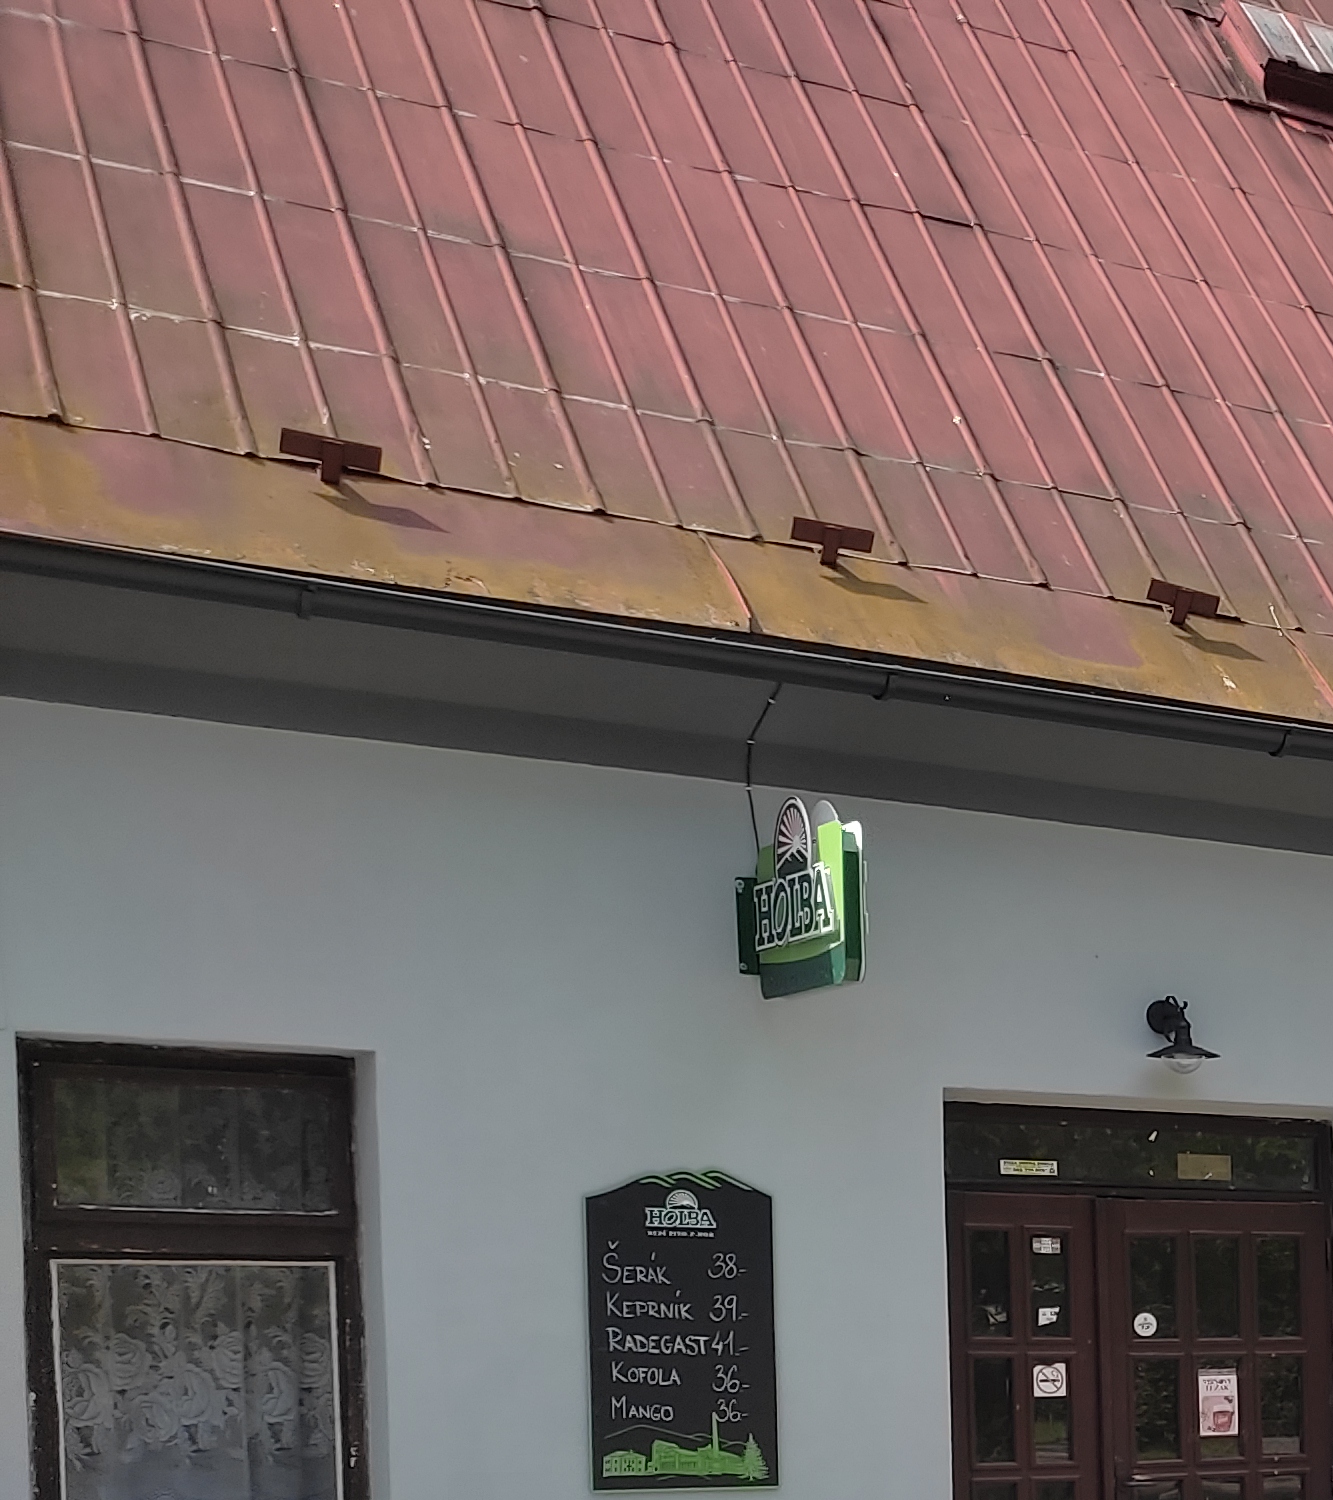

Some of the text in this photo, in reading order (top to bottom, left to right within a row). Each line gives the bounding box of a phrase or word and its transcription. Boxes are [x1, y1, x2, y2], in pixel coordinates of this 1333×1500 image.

[754, 861, 834, 951] HOLBA
[645, 1207, 716, 1228] HOLBA
[606, 1290, 694, 1321] KEPRNÍK
[605, 1327, 710, 1355] RADEGAST
[611, 1361, 681, 1386] KOFOLA
[611, 1396, 674, 1421] MANGO
